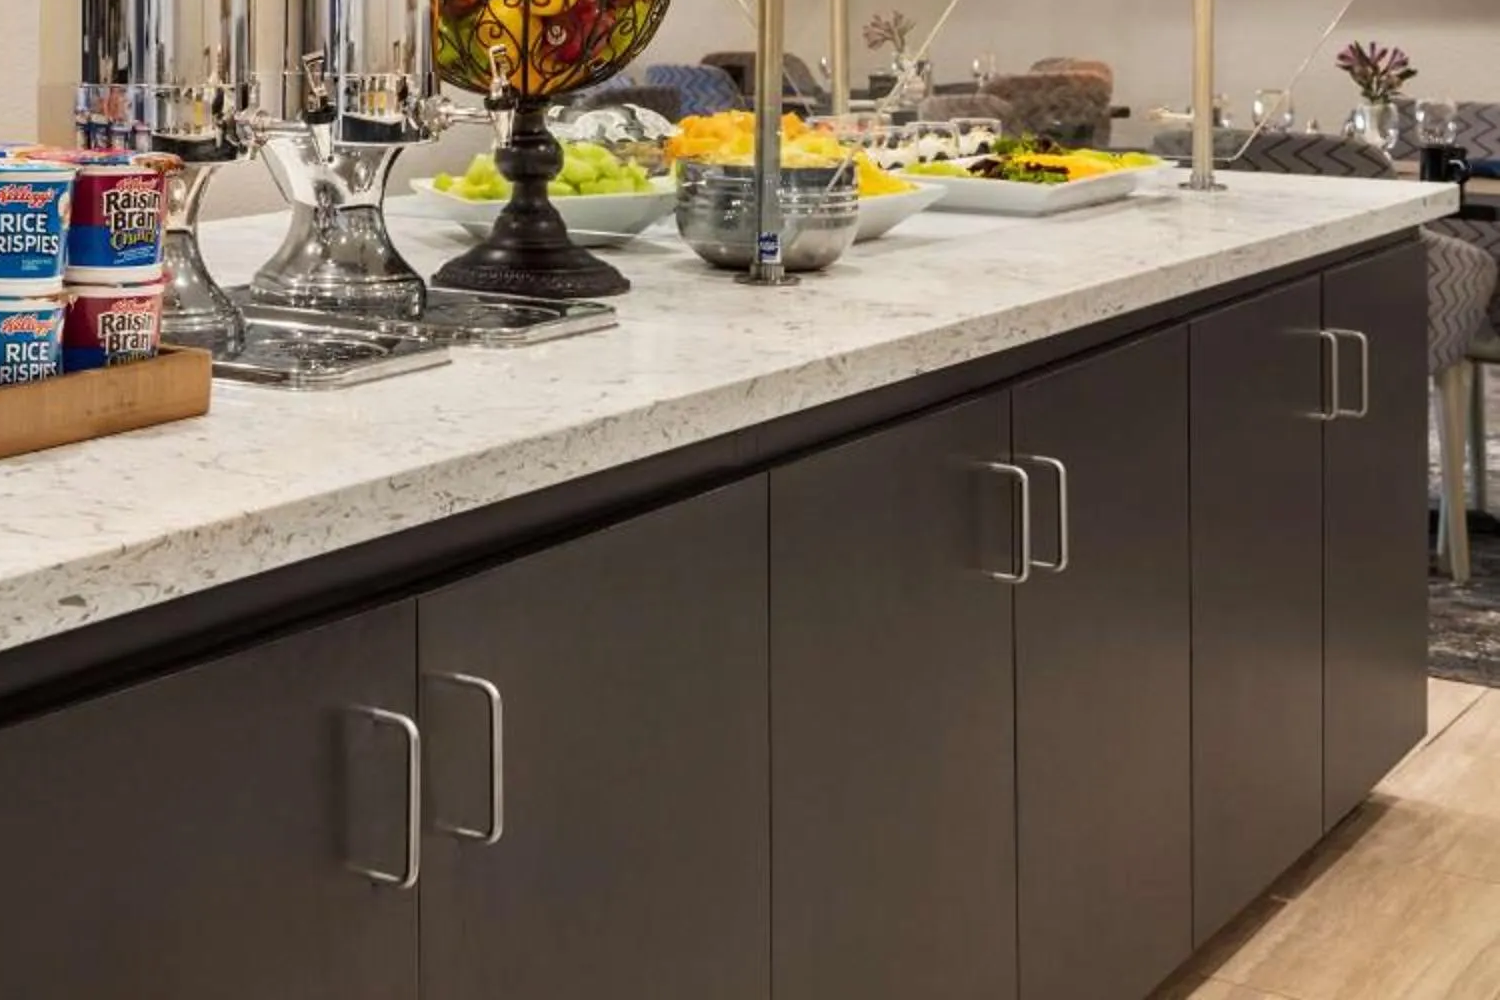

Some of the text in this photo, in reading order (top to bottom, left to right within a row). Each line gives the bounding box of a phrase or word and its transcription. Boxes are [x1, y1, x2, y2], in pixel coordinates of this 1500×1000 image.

[104, 190, 161, 215] Raisin
[0, 213, 48, 233] RICE
[112, 211, 155, 232] Bran
[6, 341, 50, 363] RICE
